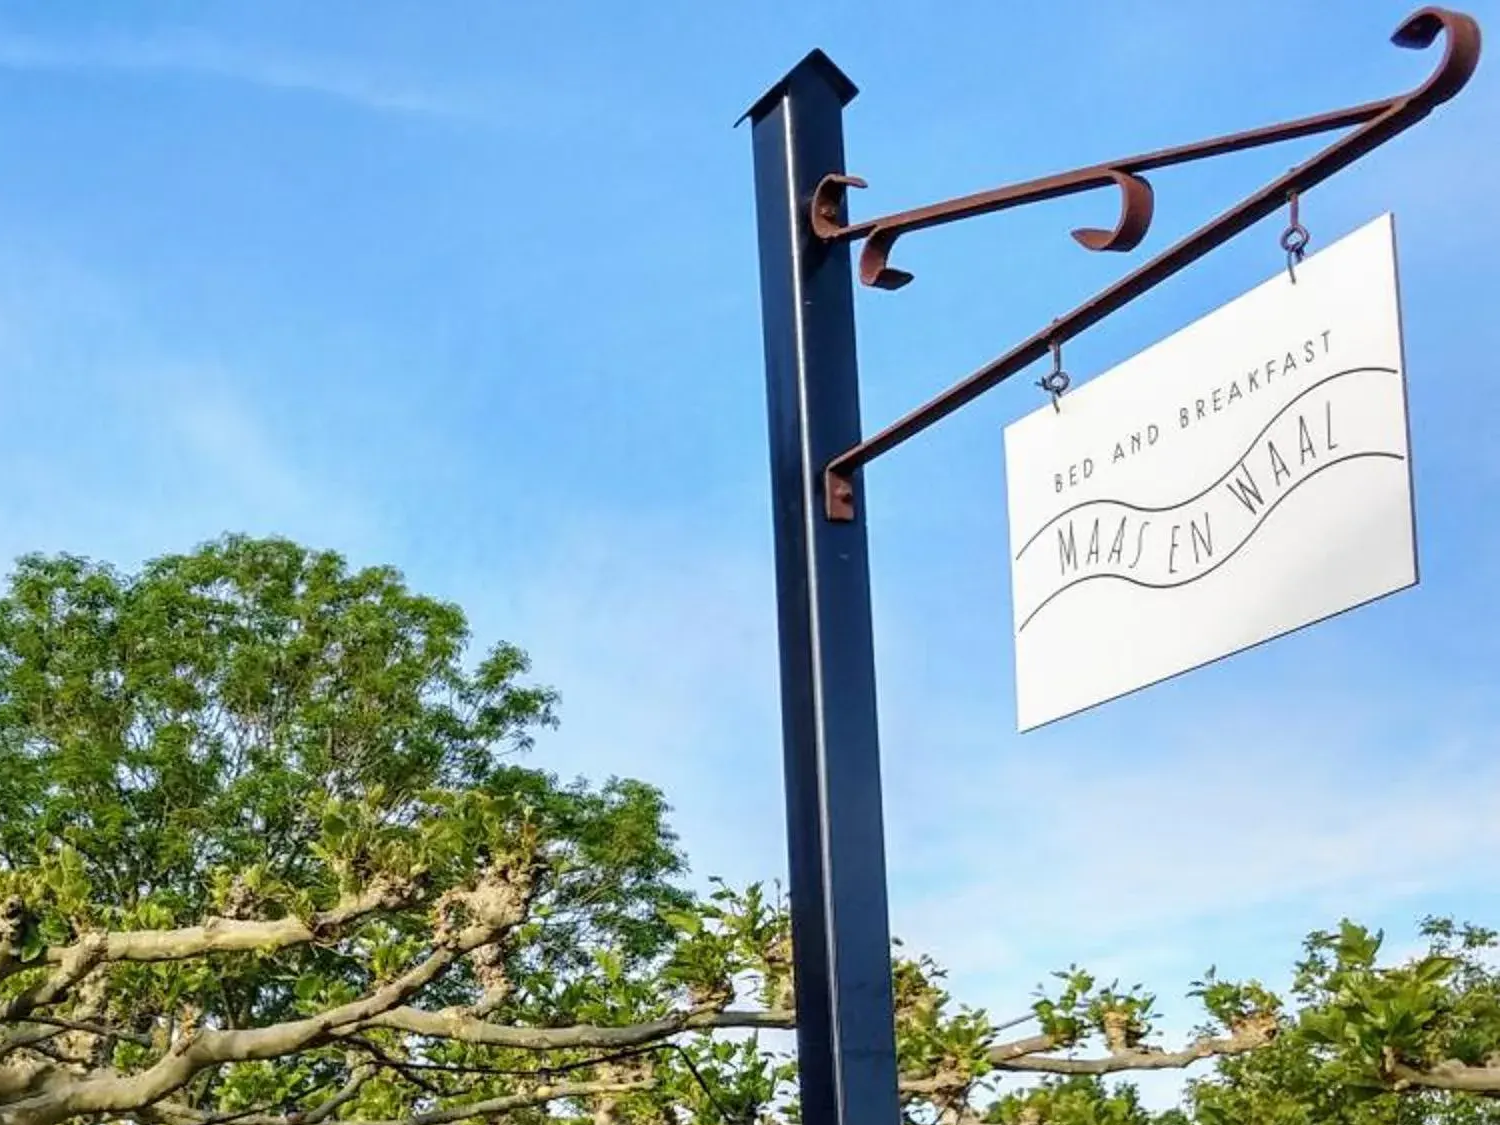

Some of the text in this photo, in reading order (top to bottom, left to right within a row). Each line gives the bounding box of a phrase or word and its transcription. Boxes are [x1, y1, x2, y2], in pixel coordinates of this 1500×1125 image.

[1054, 330, 1332, 493] BED AND BREAKFAST
[1057, 401, 1339, 575] MAAS EN WAAL
